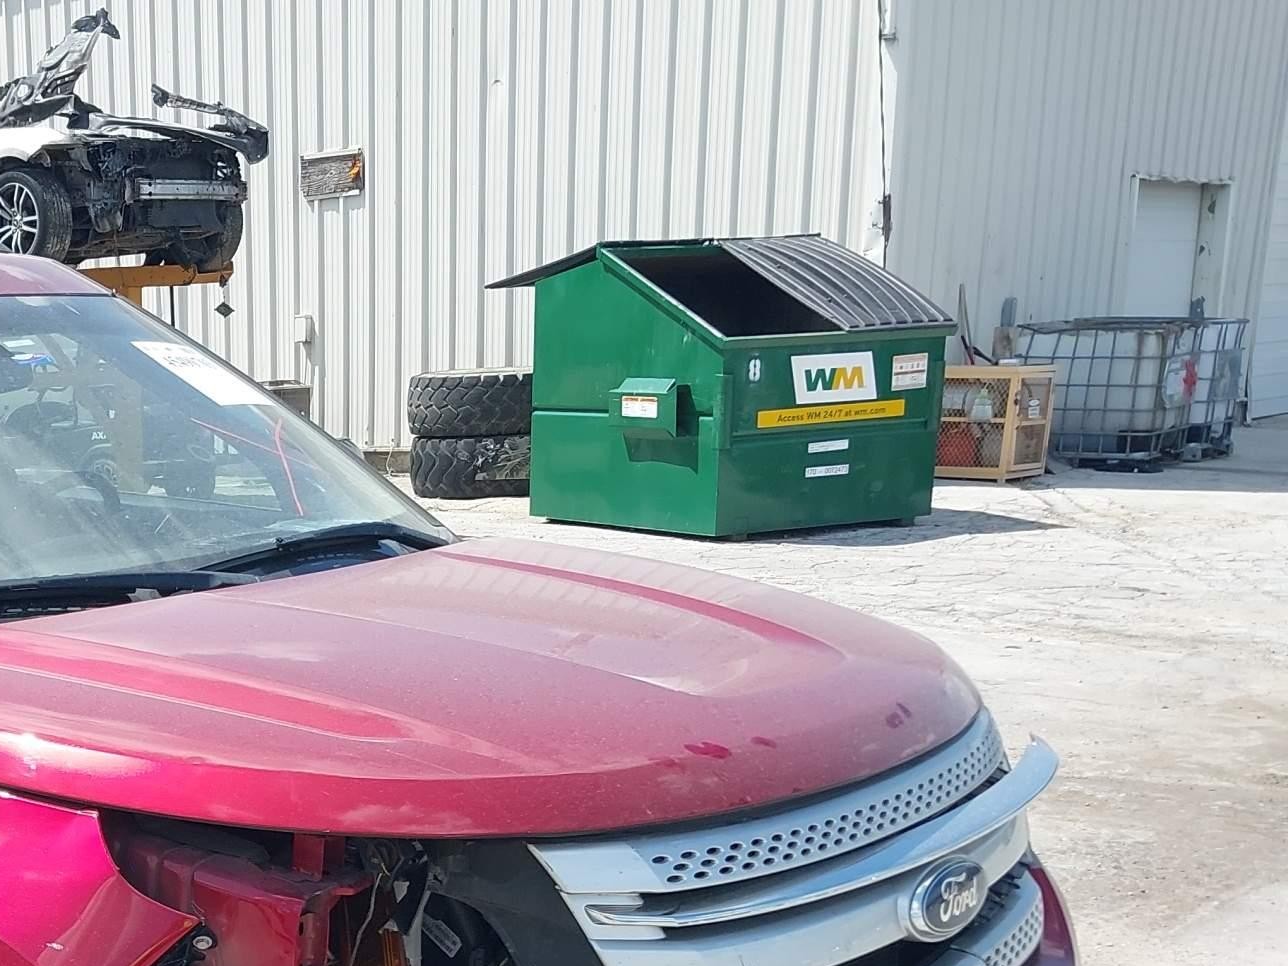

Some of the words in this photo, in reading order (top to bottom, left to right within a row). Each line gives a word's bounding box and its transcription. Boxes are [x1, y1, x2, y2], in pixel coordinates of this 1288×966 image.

[804, 365, 864, 392] WM
[777, 413, 804, 424] Access
[806, 411, 821, 420] WM
[823, 408, 843, 419] 24/7
[844, 409, 853, 417] at
[854, 407, 886, 417] wm.com
[940, 872, 977, 922] Ford
